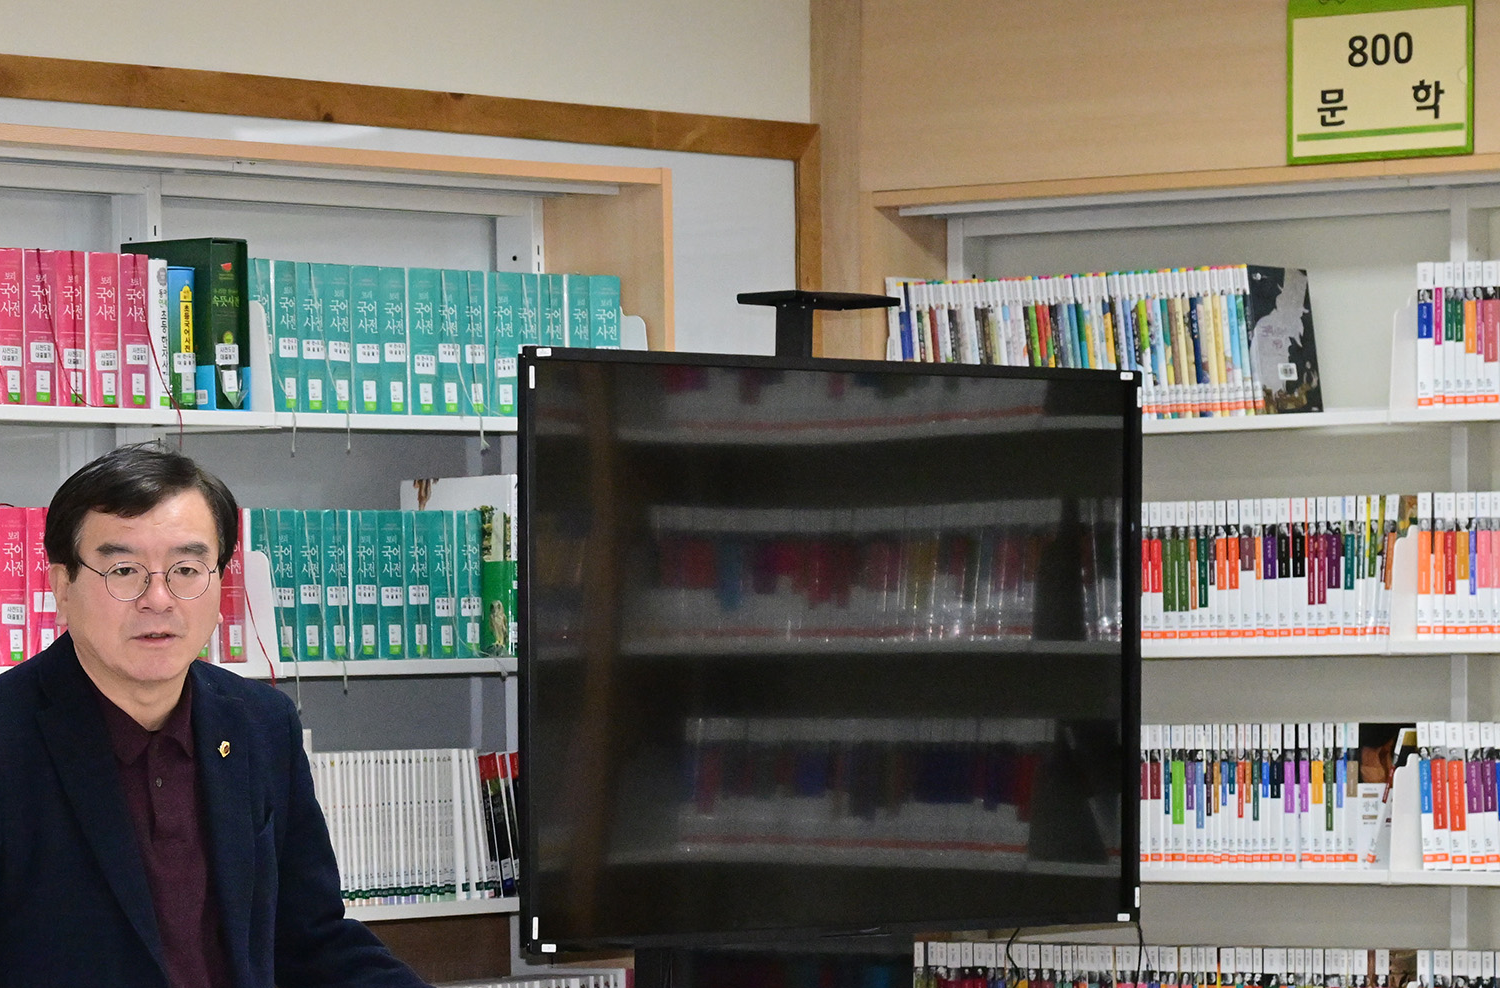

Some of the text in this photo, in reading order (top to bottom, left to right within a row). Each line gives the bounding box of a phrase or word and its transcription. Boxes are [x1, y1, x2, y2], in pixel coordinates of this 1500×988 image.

[1347, 31, 1414, 68] 800
[0, 272, 21, 317] 보리 국어 사전
[329, 299, 349, 333] 국어 사전
